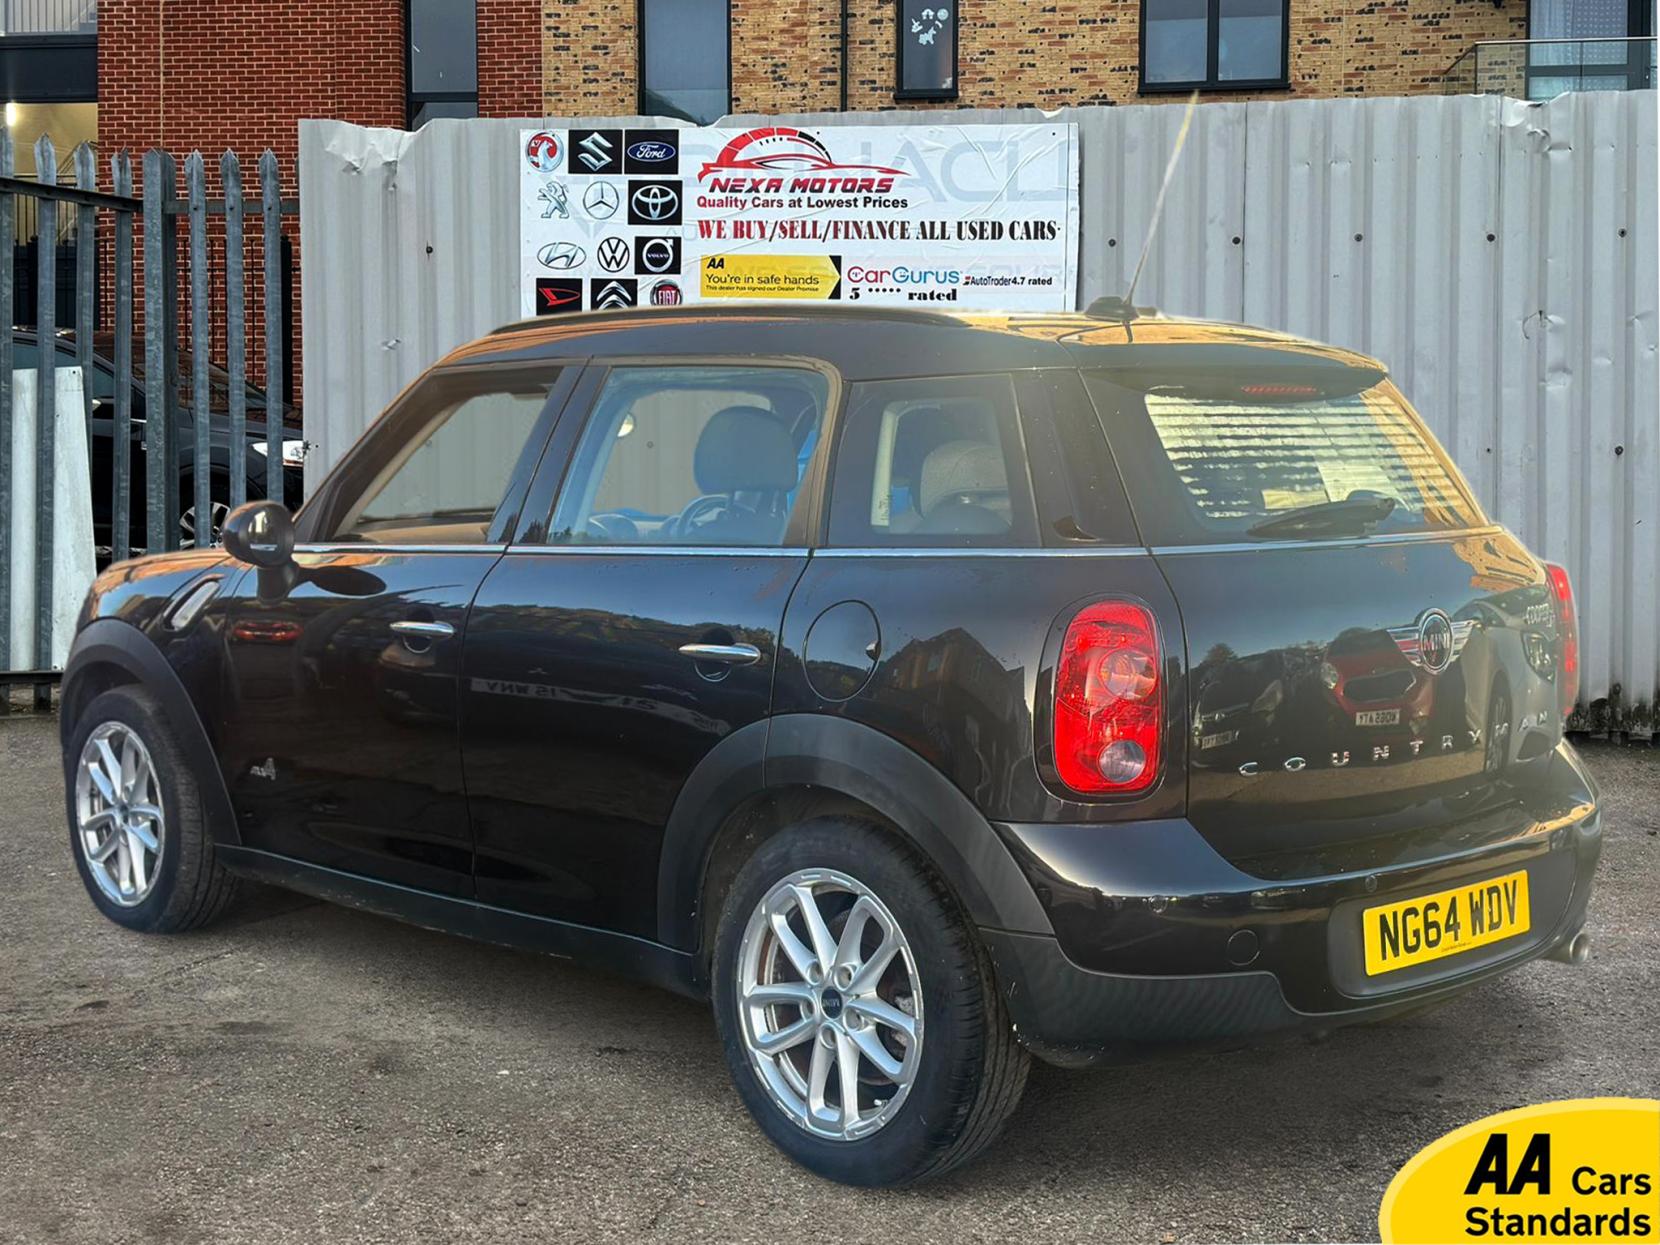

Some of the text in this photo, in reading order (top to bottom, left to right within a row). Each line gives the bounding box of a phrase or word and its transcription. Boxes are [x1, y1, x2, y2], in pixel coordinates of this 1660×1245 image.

[636, 144, 666, 159] Ford
[709, 178, 895, 194] NEXA MOTORS
[697, 196, 908, 210] Quality Cars at Lowest Prices
[697, 220, 727, 240] WE
[916, 221, 950, 240] ALL
[956, 221, 1004, 240] USED
[1008, 221, 1057, 240] CARS
[707, 257, 725, 269] AA
[706, 274, 820, 286] You're in safe hands
[847, 266, 960, 284] CarGurus
[1028, 277, 1053, 285] rated
[658, 290, 676, 304] FIAT
[849, 287, 958, 301] 5 rated
[1424, 632, 1450, 651] MINI
[1238, 711, 1548, 777] COUNTRYMAN
[1379, 880, 1518, 961] NG64 WDV
